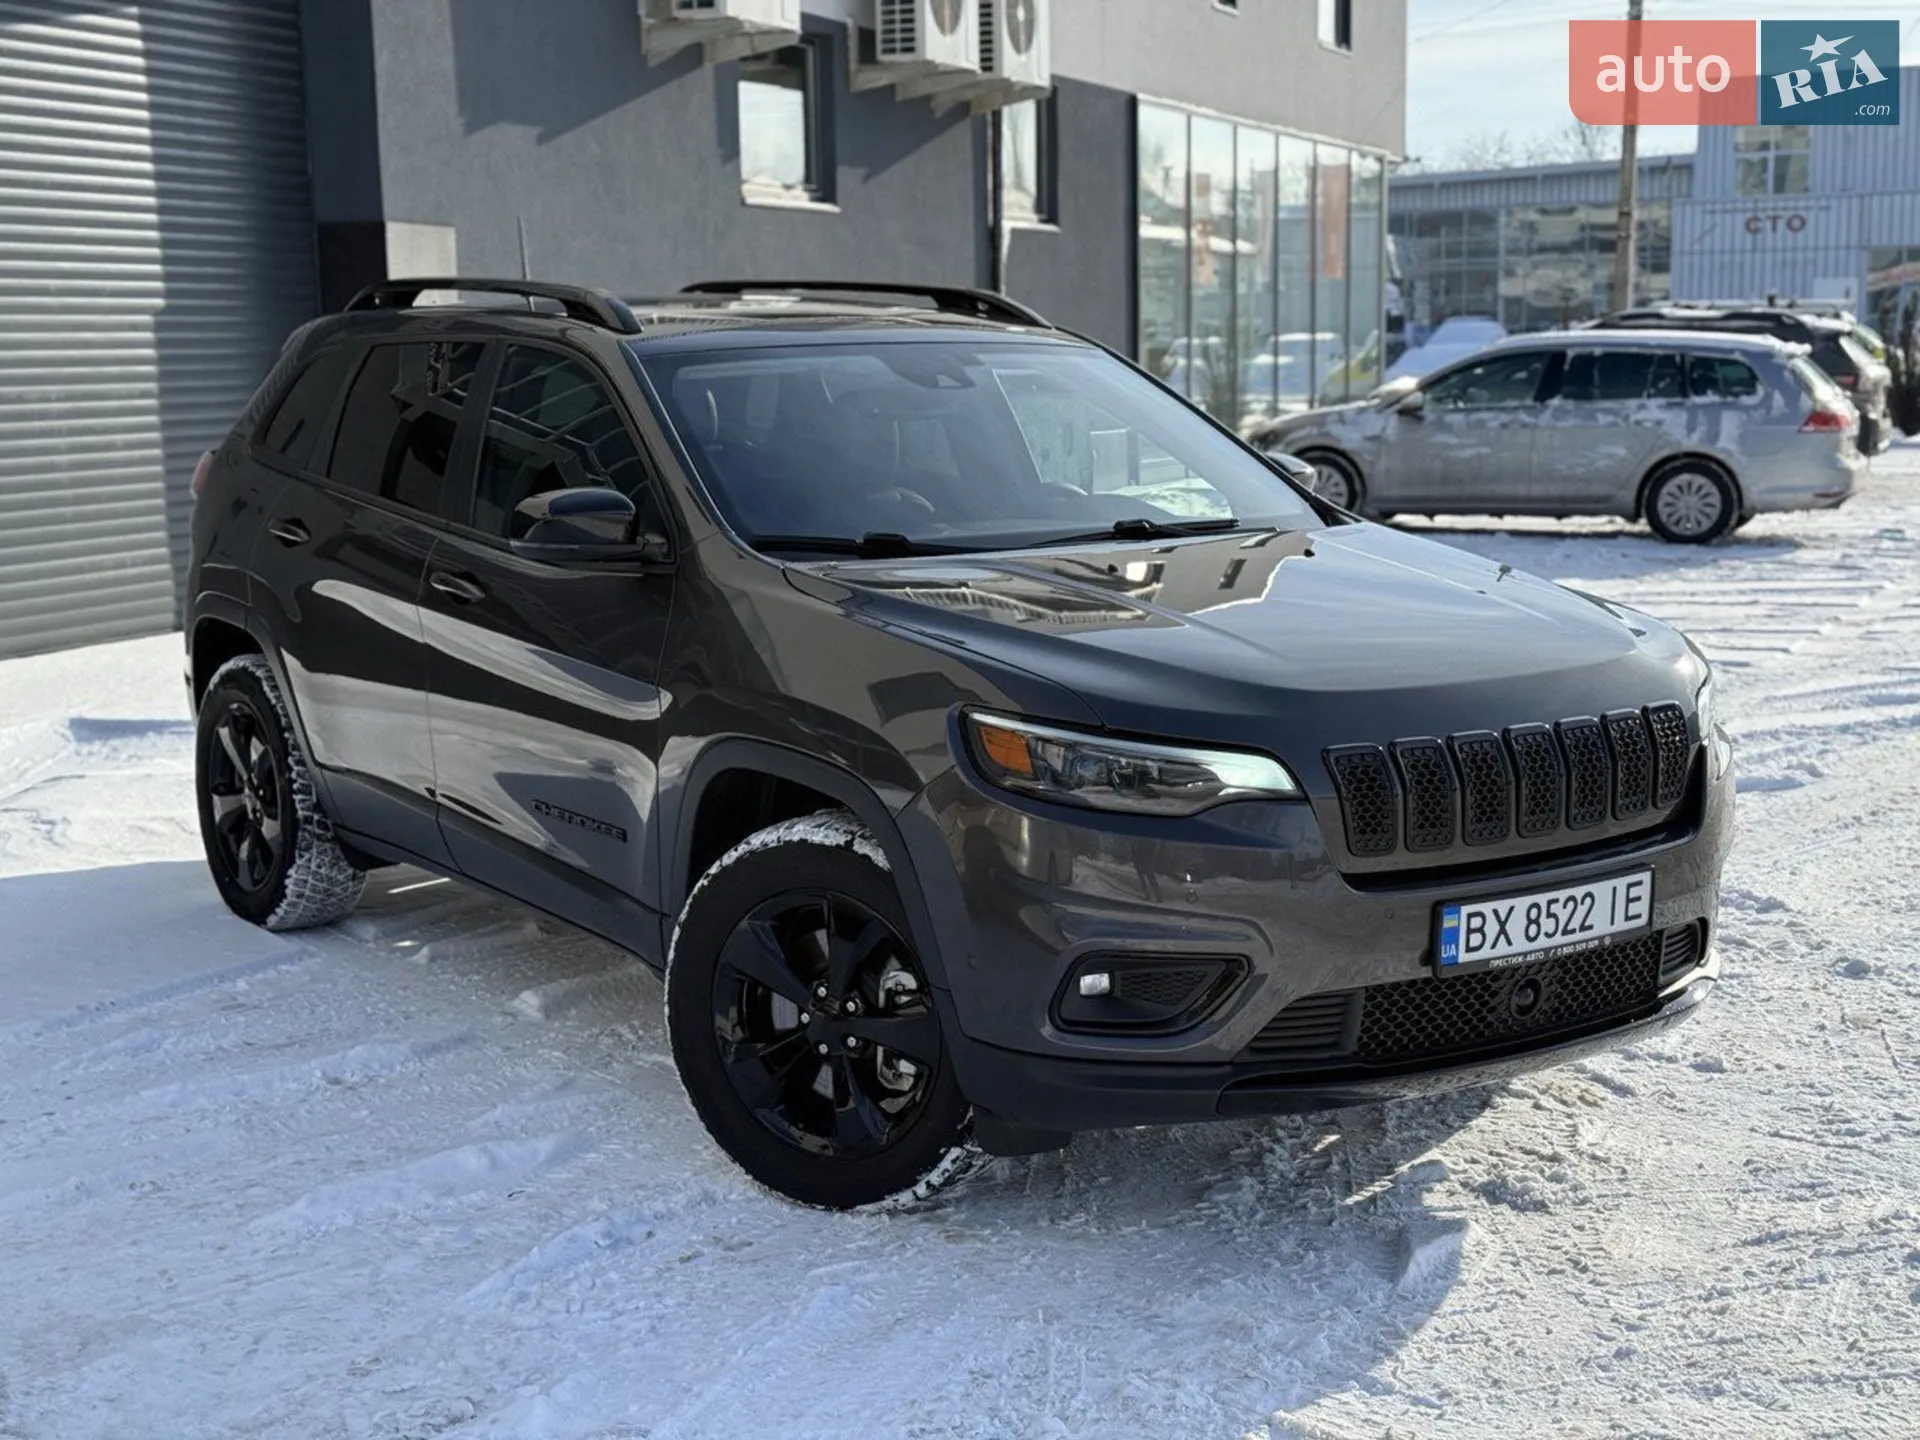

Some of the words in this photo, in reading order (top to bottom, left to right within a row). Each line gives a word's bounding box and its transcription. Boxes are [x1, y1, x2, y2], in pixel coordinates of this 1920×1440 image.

[1744, 214, 1808, 235] СТО
[532, 799, 628, 843] CHEROKEE
[1464, 905, 1515, 953] BX
[1524, 891, 1596, 943] 8522
[1609, 880, 1644, 927] IE
[1441, 944, 1457, 957] UA
